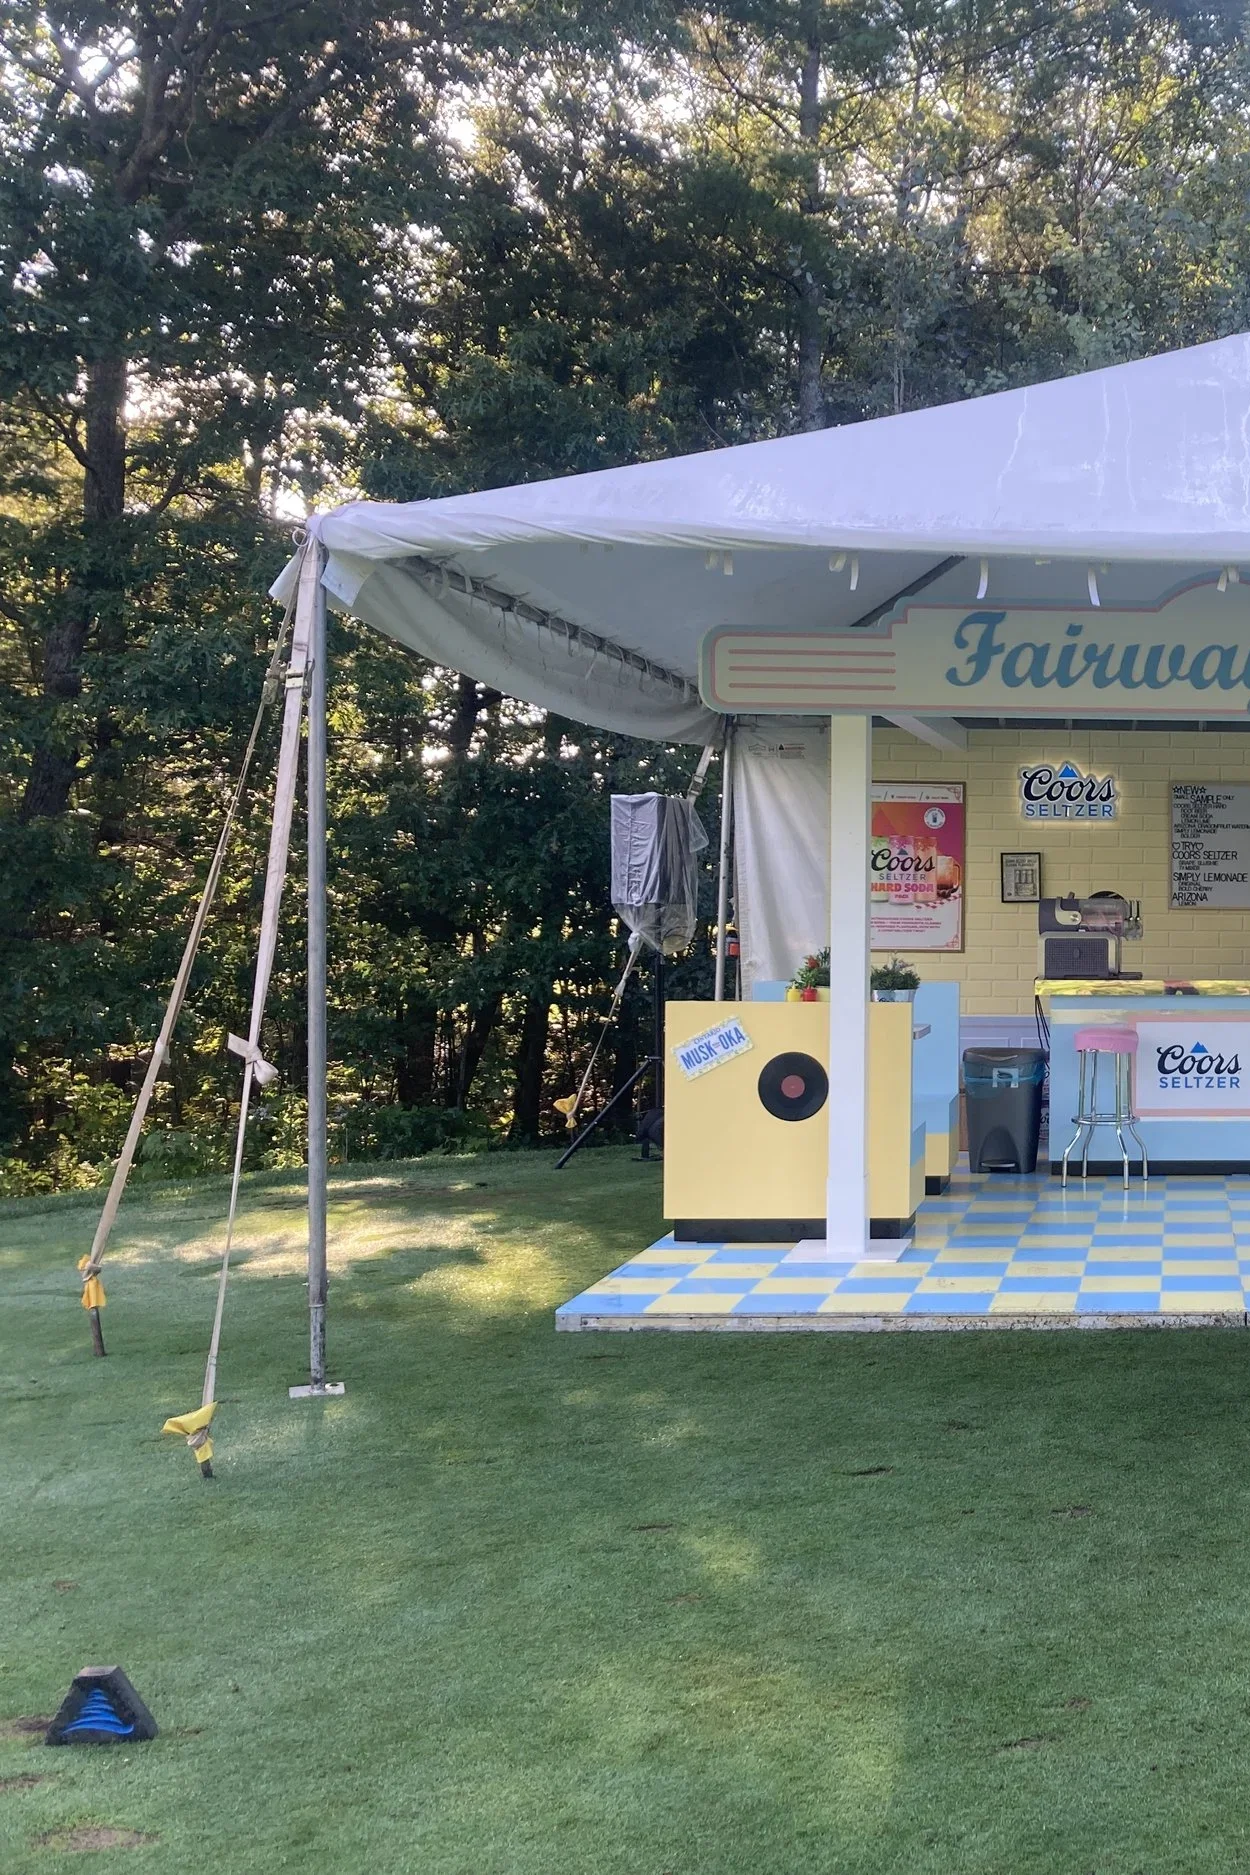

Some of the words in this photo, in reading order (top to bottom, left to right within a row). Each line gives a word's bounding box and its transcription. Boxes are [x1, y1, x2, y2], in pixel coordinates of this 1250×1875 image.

[1022, 768, 1115, 802] Coors
[1190, 794, 1222, 804] SAMPLE
[1025, 803, 1113, 817] SELTZER
[1181, 841, 1196, 851] TRY
[871, 848, 936, 872] Coors
[1172, 850, 1201, 860] COORS
[1203, 850, 1238, 860] SELTZER
[879, 872, 927, 881] SELTZER
[1173, 871, 1201, 882] SIMPLY
[1203, 872, 1248, 882] LEMONADE
[871, 882, 902, 892] HARD
[904, 882, 934, 893] SODA
[1172, 892, 1208, 902] ARIZONA
[1156, 1044, 1242, 1075] Coors
[1159, 1076, 1241, 1089] SELTZER
